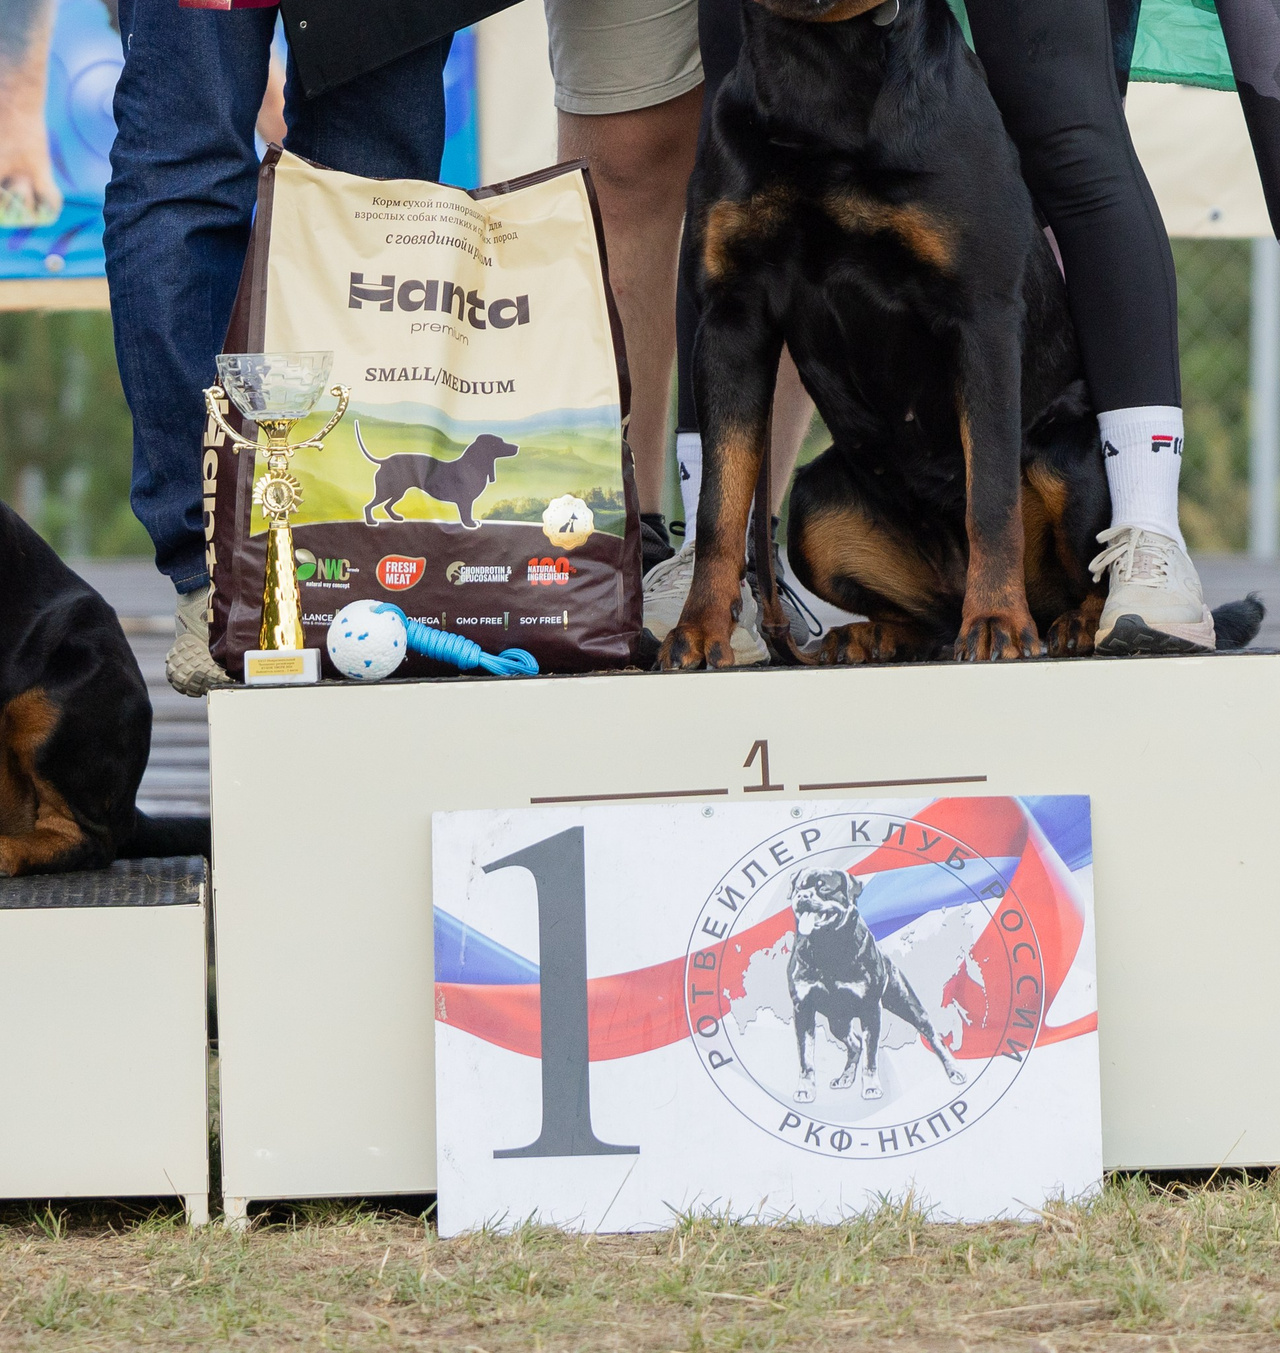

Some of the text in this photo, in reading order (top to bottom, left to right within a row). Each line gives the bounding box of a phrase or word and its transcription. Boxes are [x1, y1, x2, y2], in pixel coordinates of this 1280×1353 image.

[372, 197, 401, 209] Корм
[403, 199, 434, 211] сухой
[488, 220, 502, 232] для
[354, 211, 405, 222] взрослых
[407, 213, 437, 223] собак
[440, 215, 473, 230] мелких
[493, 231, 519, 244] пород
[385, 234, 393, 244] с
[396, 230, 467, 252] говядиной
[467, 243, 474, 255] и
[348, 271, 531, 330] Hanta
[410, 321, 470, 346] premium
[364, 366, 516, 395] SMALL/MEDIUM
[317, 557, 351, 582] NWC
[385, 561, 417, 574] FRESH
[385, 573, 411, 585] MEAT
[460, 566, 513, 575] CHONDROTIN &
[460, 574, 509, 583] GLUCOSAMINE
[527, 565, 557, 573] NATURAL
[527, 572, 570, 582] INGREDIENTS
[456, 617, 503, 625] GMO FREE
[519, 616, 562, 625] SOY FREE
[743, 739, 785, 793] 1
[691, 819, 1040, 1071] РОТВЕЙЛЕР КЛУБ РОССИИ
[481, 824, 641, 1160] 1
[777, 1098, 971, 1154] РКФ-НКПР
